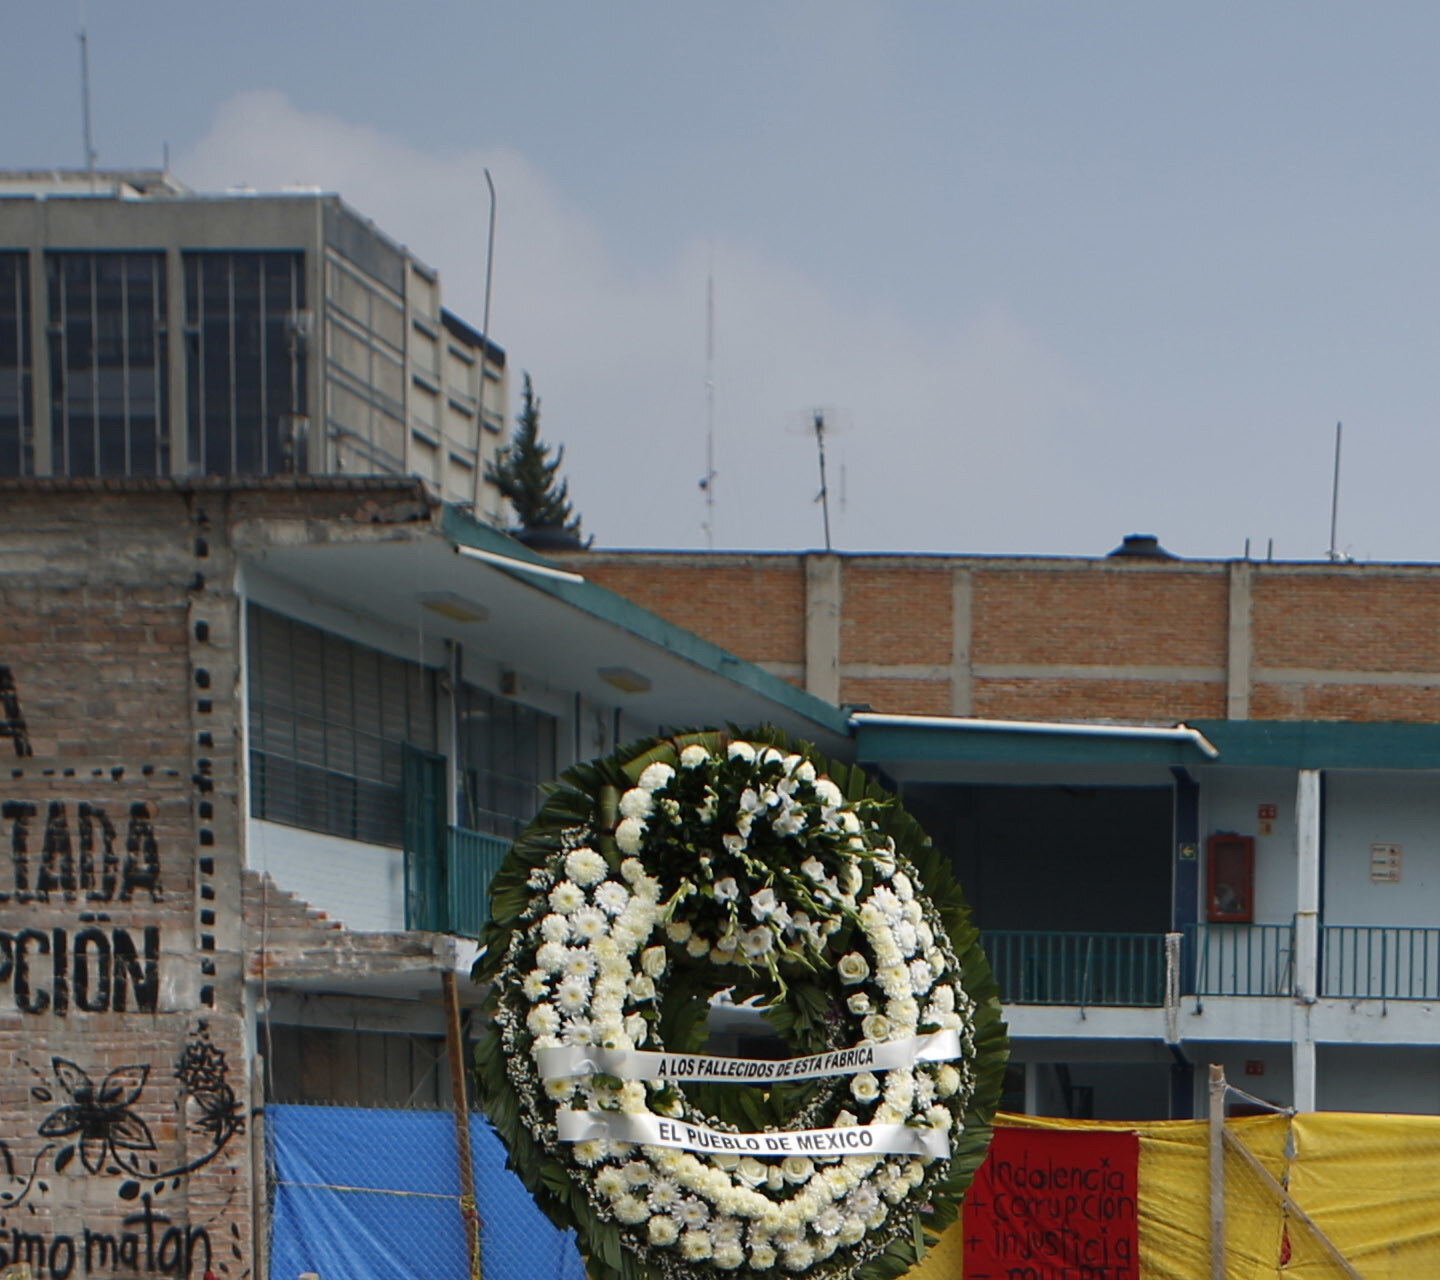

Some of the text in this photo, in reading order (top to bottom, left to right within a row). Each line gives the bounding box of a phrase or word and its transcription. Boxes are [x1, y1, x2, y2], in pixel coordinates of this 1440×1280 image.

[658, 1047, 874, 1077] A LOS FALLECIDOS DE ESTA FABRICA
[659, 1122, 874, 1151] EL PUEBLO DE MEXICO
[84, 1192, 212, 1280] matan
